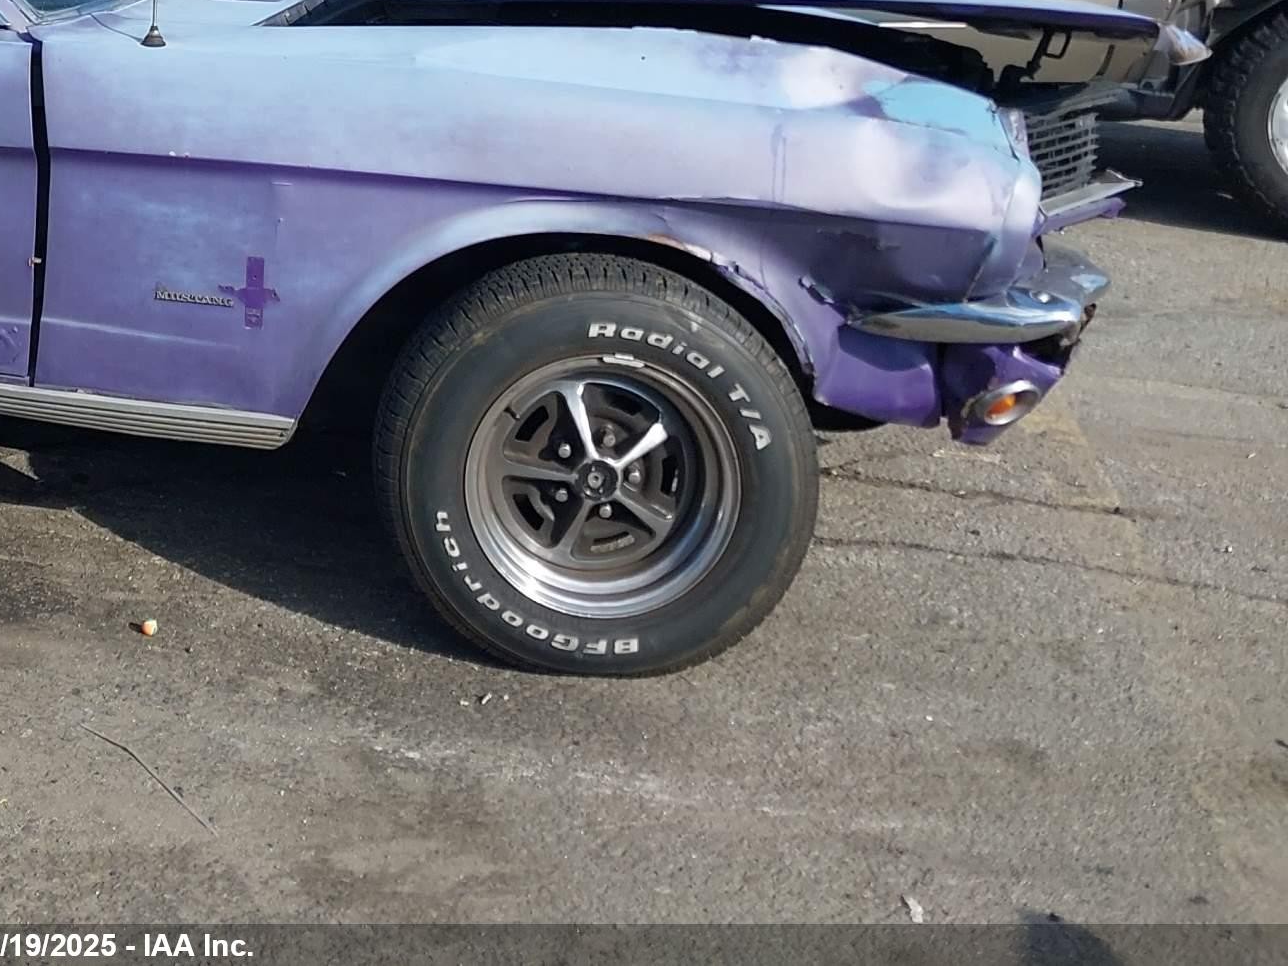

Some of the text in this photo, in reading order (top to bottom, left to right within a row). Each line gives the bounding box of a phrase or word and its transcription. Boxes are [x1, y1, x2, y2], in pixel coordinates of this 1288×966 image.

[155, 291, 234, 307] MUSTANG
[588, 322, 772, 450] Radial T/A
[435, 511, 639, 655] BFGoodrich
